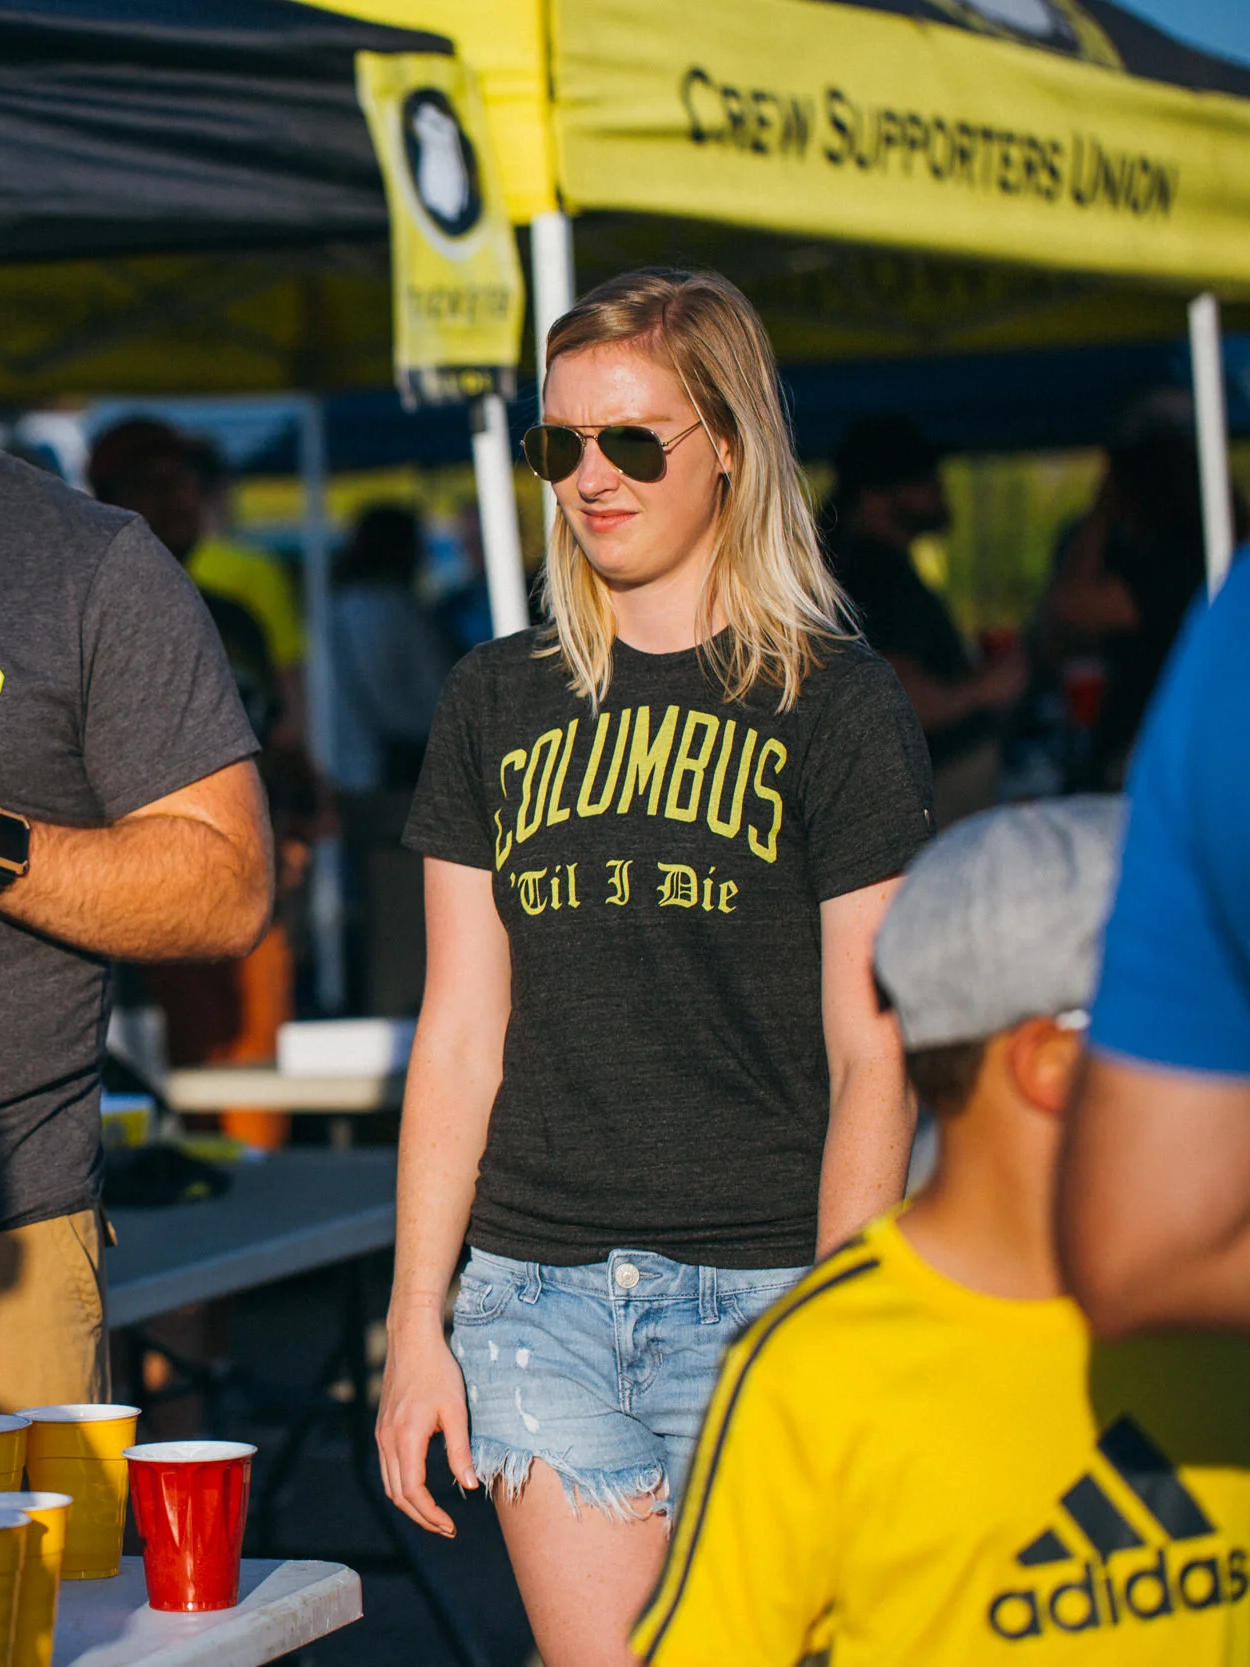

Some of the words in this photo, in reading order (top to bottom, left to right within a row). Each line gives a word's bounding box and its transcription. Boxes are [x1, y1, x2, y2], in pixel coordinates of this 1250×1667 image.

[681, 66, 815, 162] CREW
[823, 86, 1063, 206] SUPPORTERS
[1071, 131, 1180, 219] UNION
[494, 705, 788, 872] COLUMBUS
[605, 859, 633, 906] I
[657, 862, 739, 914] Die
[987, 1548, 1249, 1640] adidas
